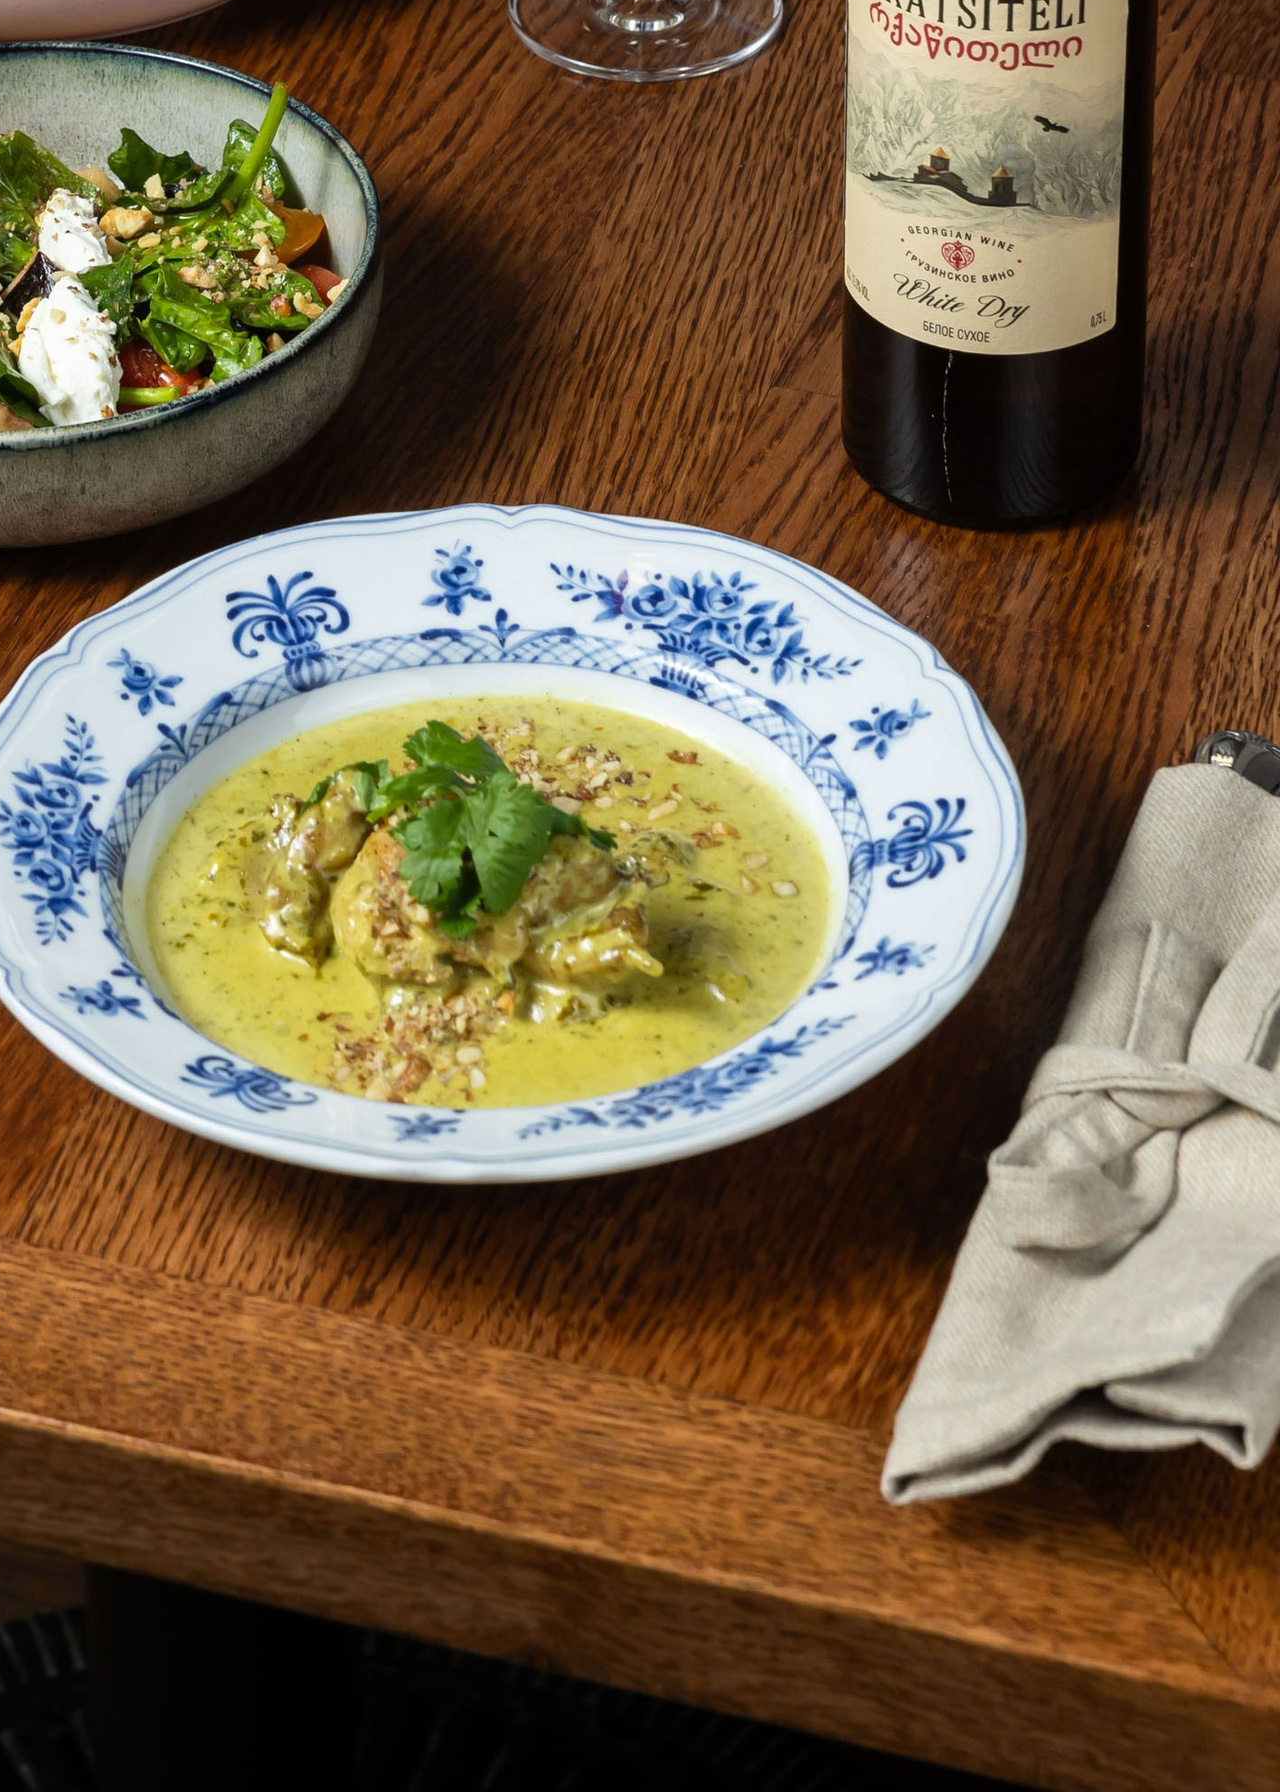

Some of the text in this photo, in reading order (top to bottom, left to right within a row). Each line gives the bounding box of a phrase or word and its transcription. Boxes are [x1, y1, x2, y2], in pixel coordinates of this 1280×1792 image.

[869, 1, 1083, 71] რქაწითელი
[907, 225, 1015, 253] GEORGIAN WINE
[905, 250, 1015, 284] ГРУЗИНСКОЕ ВИНО
[893, 273, 965, 313] White
[977, 294, 1030, 329] Dry
[922, 320, 991, 343] БЕЛОЕ СУХОЕ
